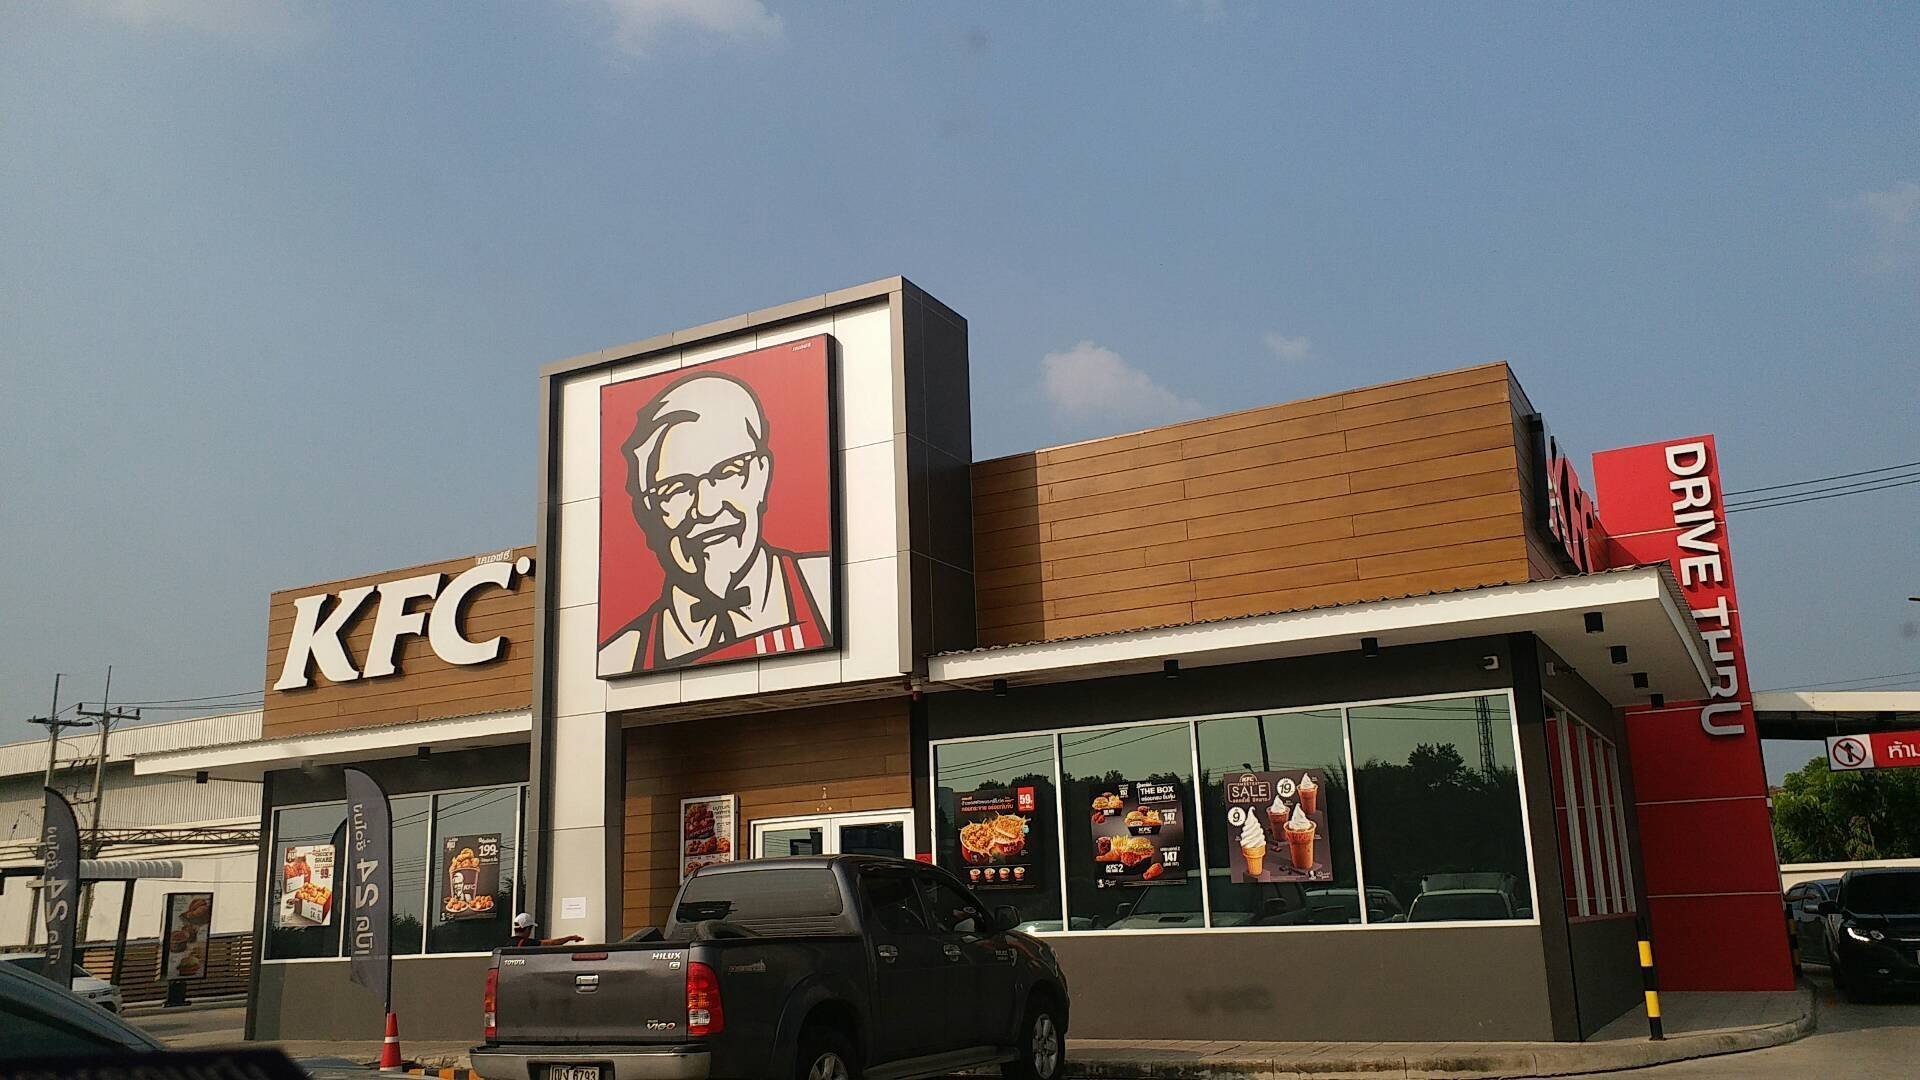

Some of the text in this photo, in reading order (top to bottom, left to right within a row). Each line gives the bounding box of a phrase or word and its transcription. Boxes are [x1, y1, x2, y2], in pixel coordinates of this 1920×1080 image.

[1664, 441, 1745, 735] DRIVE THRU
[273, 561, 515, 691] KFC
[1140, 787, 1155, 796] THE
[1156, 785, 1174, 794] BOX
[1232, 784, 1267, 798] SALE
[652, 951, 681, 961] HILUX
[504, 959, 525, 967] TOYOTA
[646, 1021, 676, 1031] VIGO
